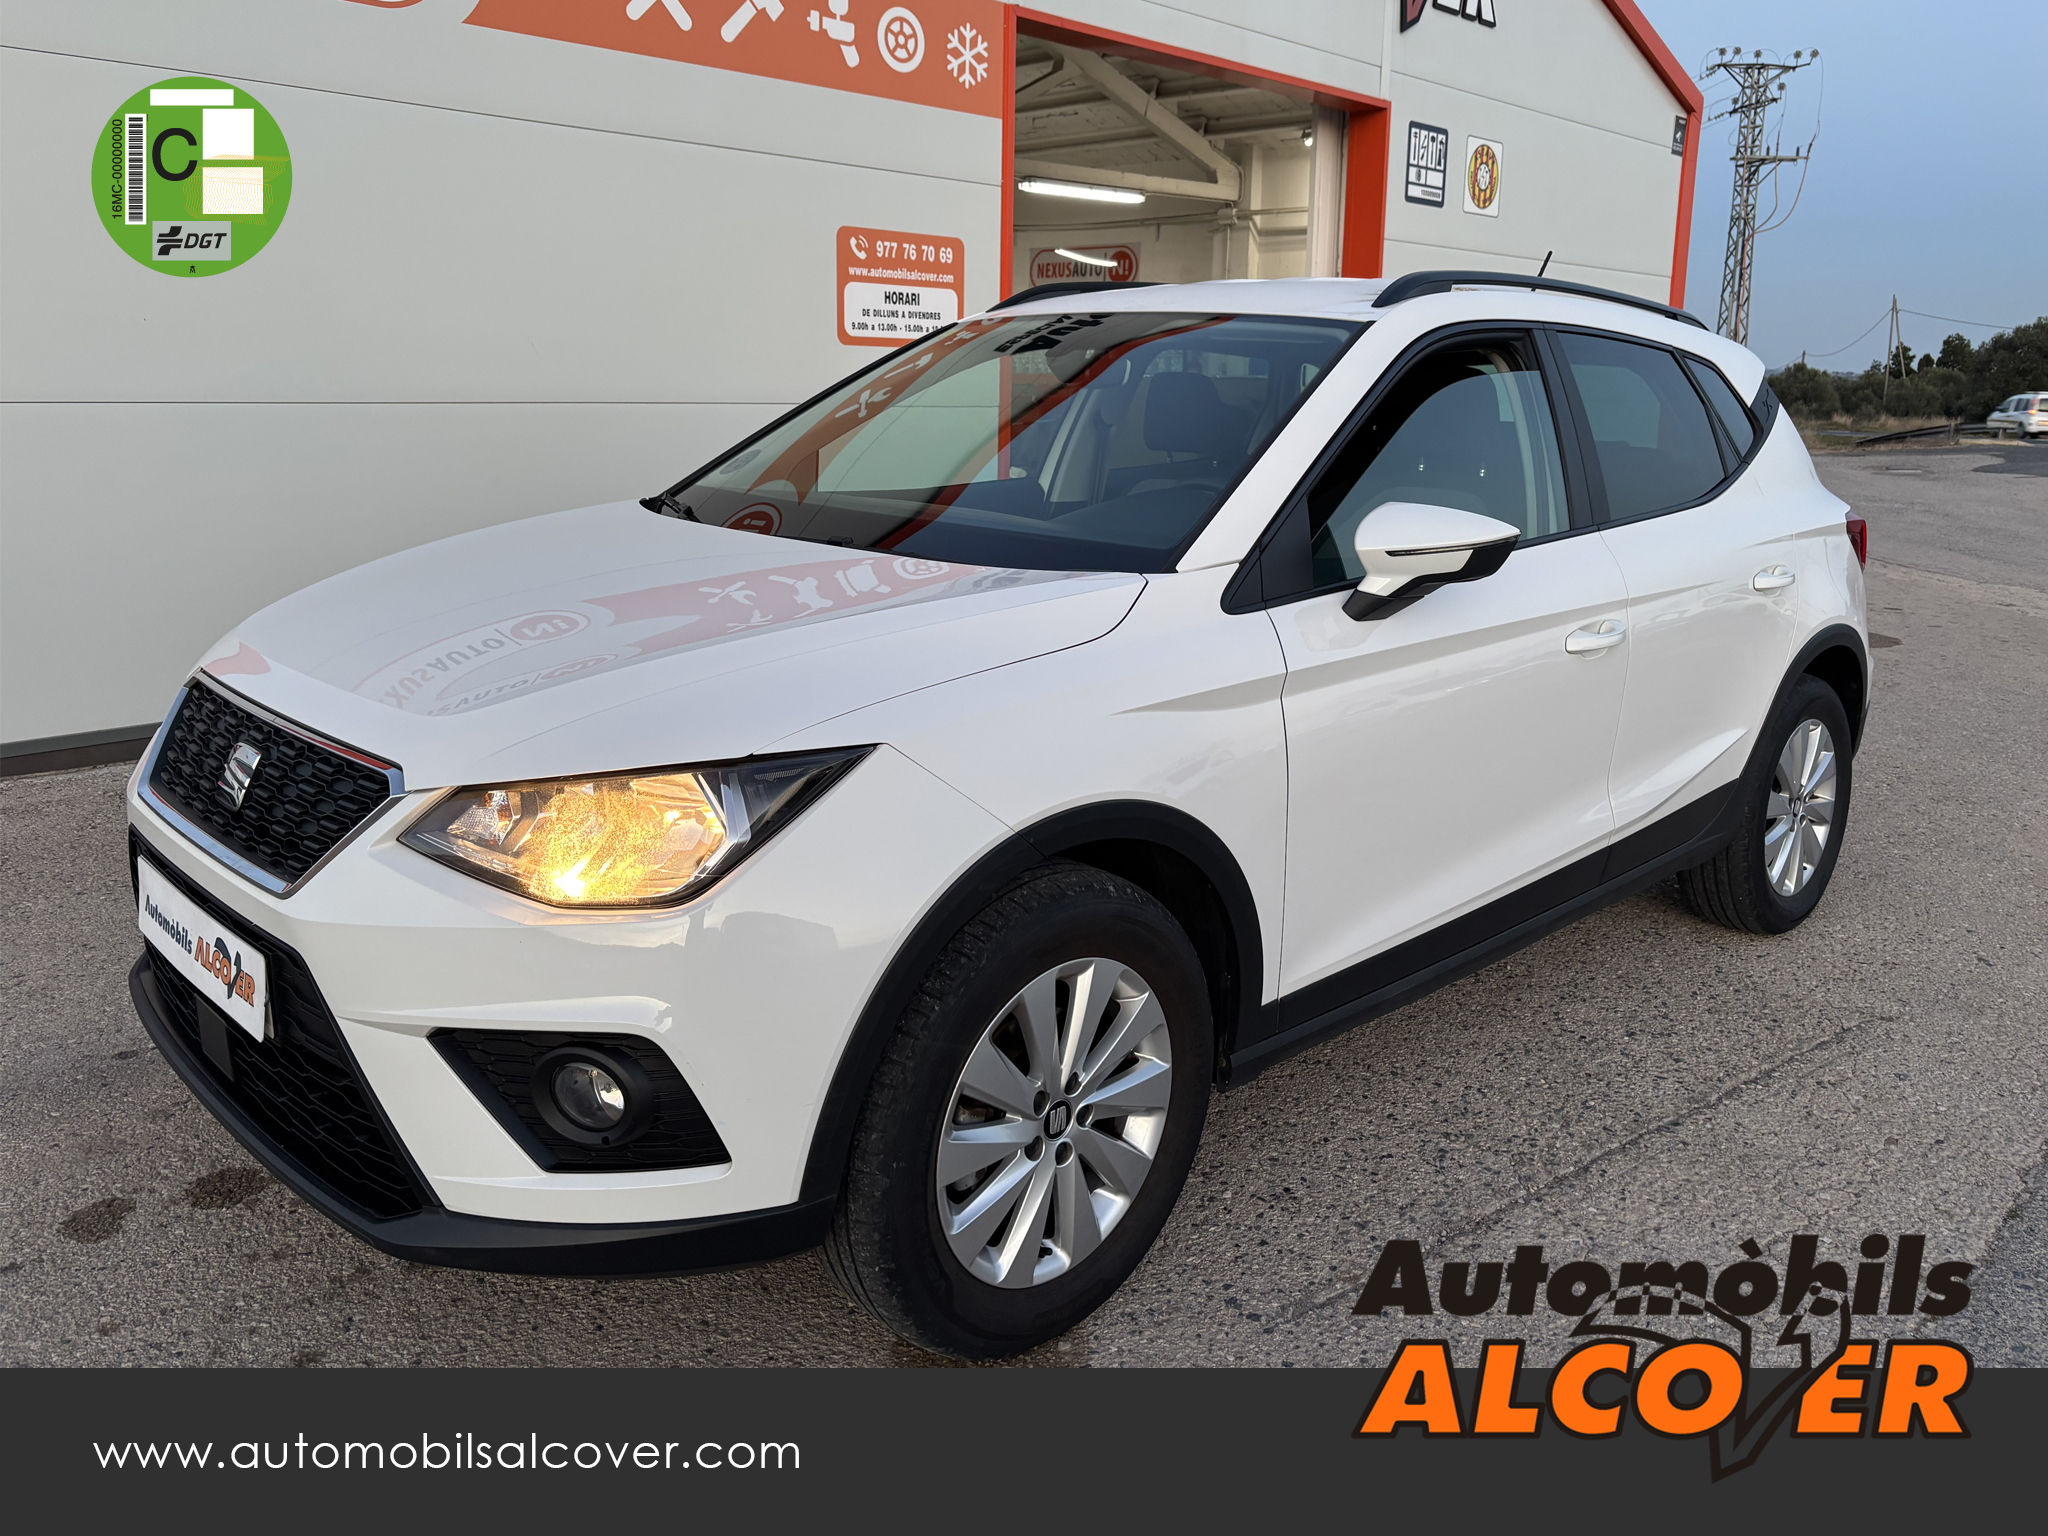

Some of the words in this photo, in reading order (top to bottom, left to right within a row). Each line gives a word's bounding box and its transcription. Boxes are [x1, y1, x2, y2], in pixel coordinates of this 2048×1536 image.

[875, 240, 898, 259] 977
[902, 243, 917, 260] 76
[921, 245, 935, 262] 70
[939, 247, 953, 264] 69
[848, 266, 954, 283] www.automobilsalcover.com
[884, 291, 920, 306] HORARI
[862, 308, 870, 317] DE
[873, 309, 899, 319] DILLUNS
[901, 311, 906, 319] A
[908, 311, 941, 321] DIVENDRES
[851, 321, 869, 331] 9.00h
[878, 323, 898, 332] 13.00h
[904, 324, 924, 333] 15.00h
[144, 894, 193, 955] Automòbils
[194, 936, 256, 1008] ALCOVER
